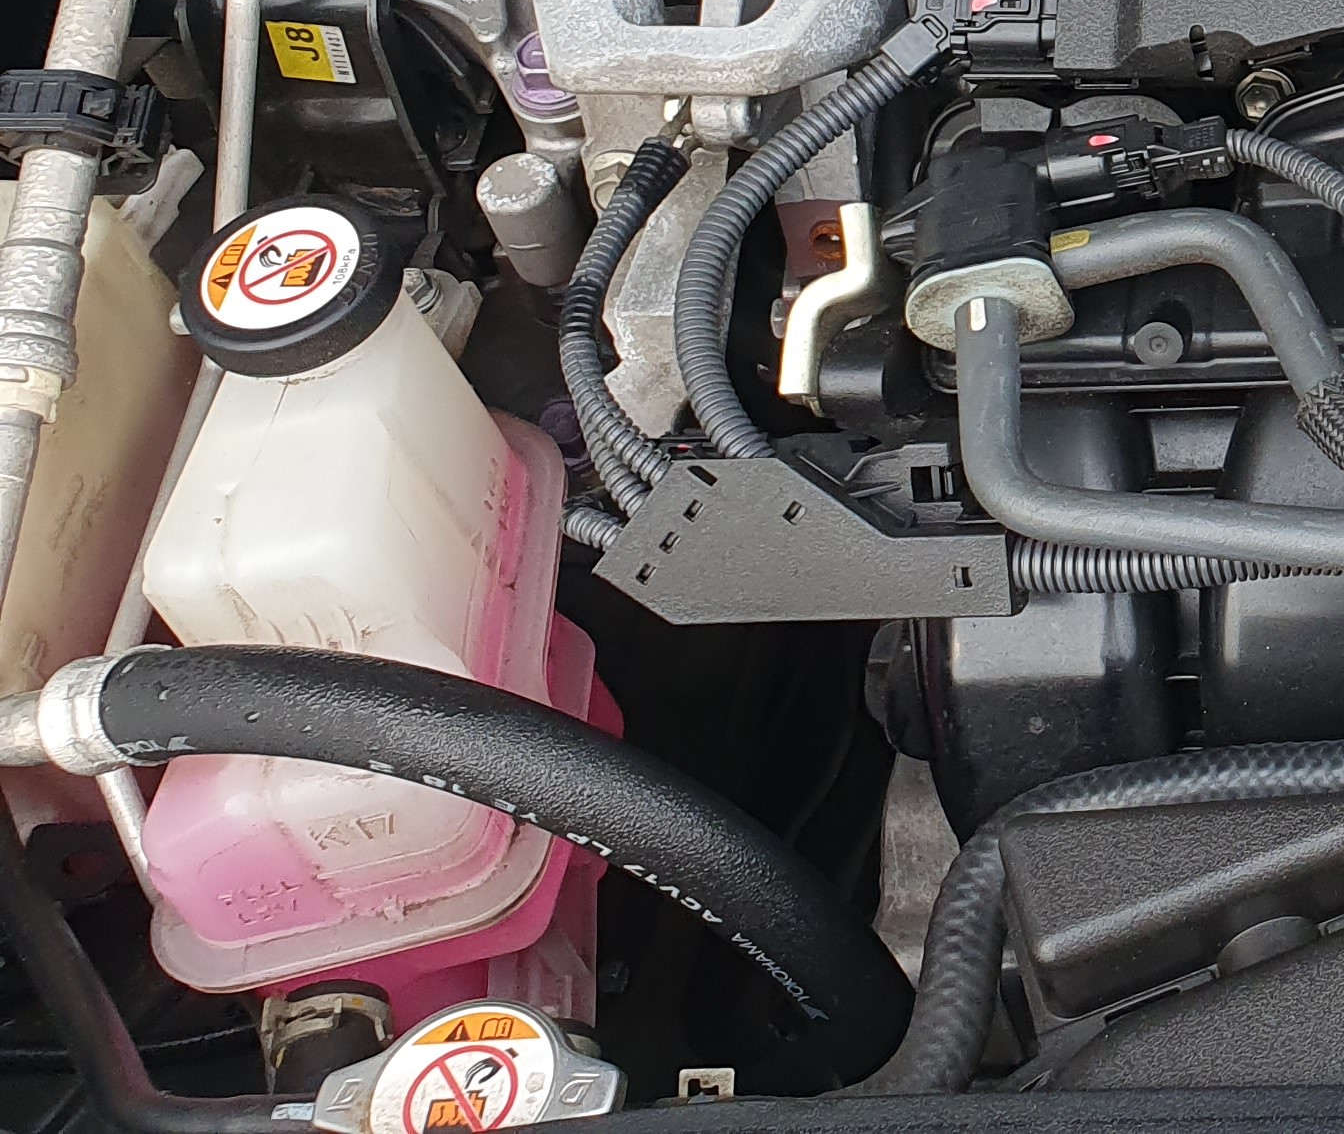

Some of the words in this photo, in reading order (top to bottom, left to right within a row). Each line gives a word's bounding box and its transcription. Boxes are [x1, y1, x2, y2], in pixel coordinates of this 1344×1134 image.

[285, 26, 320, 62] J8
[332, 248, 357, 285] 108kPa
[567, 832, 613, 857] LP
[623, 864, 723, 923] ACV17
[732, 933, 810, 1001] YOKOHAMA
